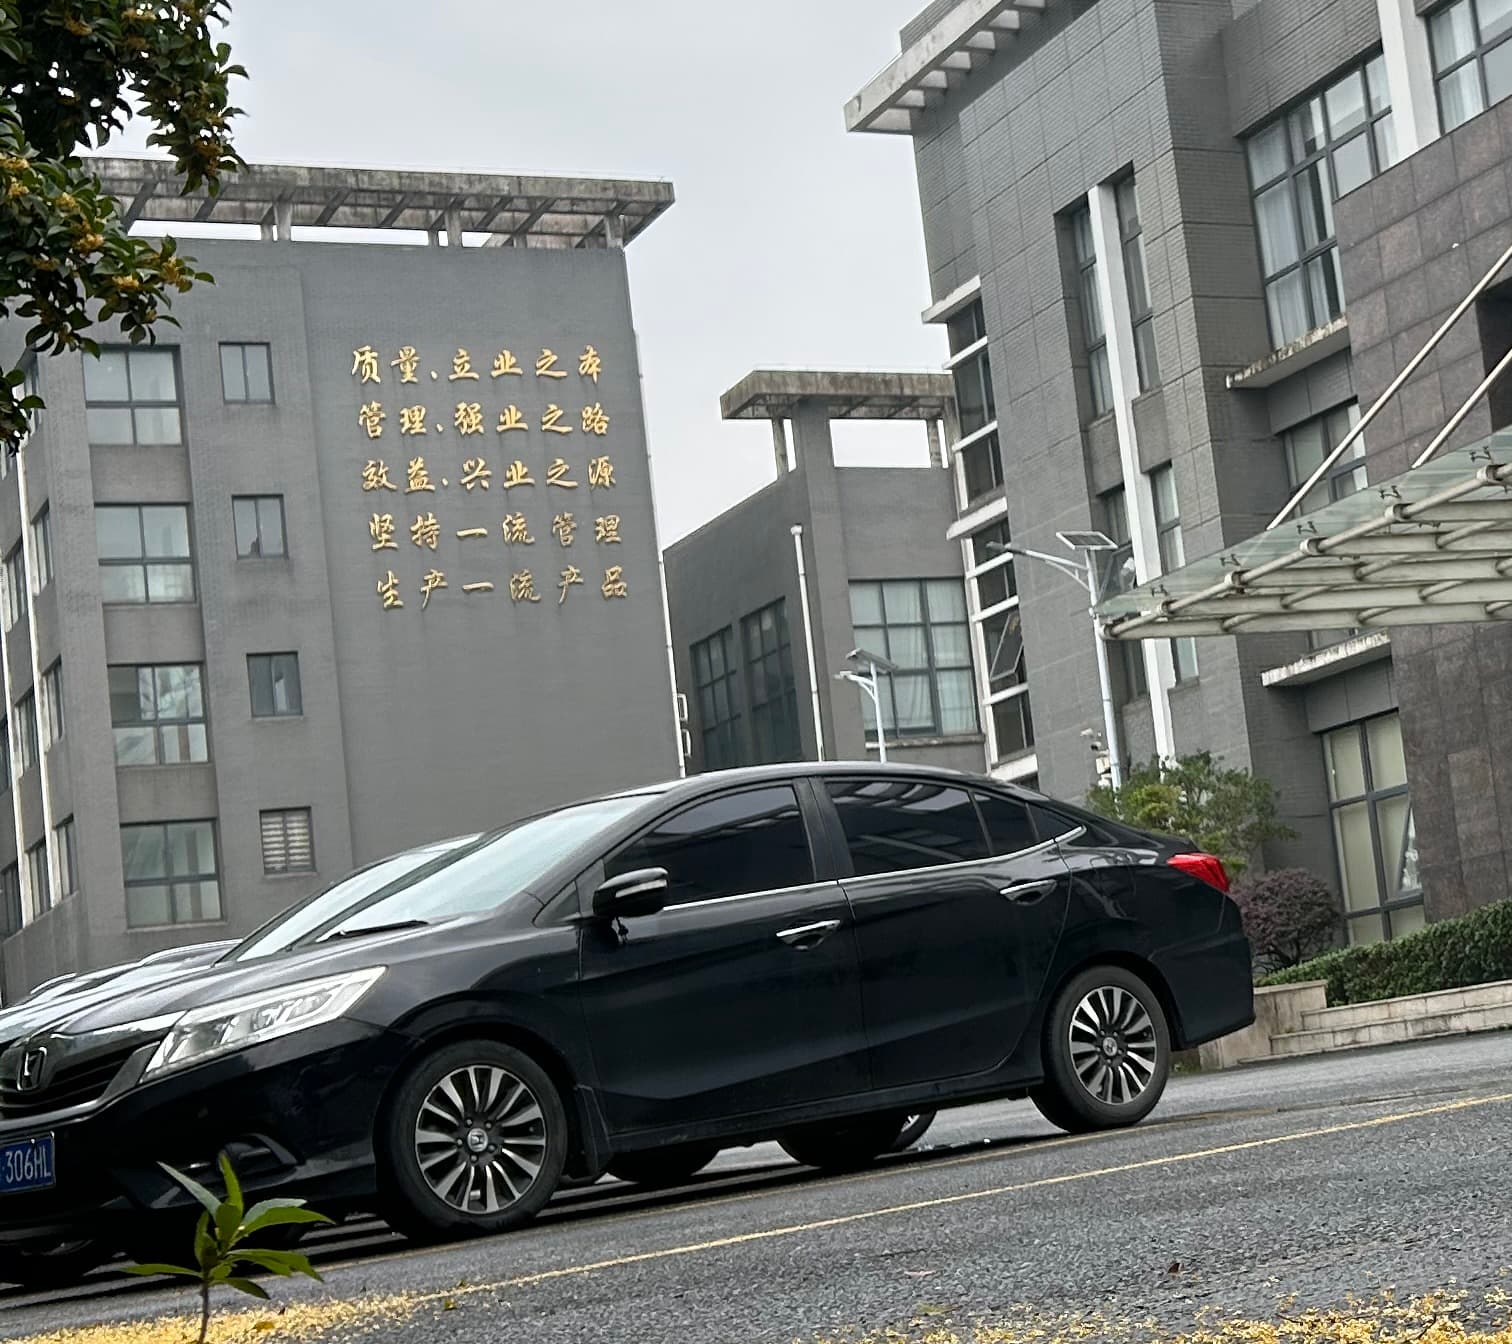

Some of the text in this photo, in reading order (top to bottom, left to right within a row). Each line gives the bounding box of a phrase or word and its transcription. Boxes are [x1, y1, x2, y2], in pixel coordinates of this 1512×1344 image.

[368, 512, 622, 551] 坚持一流管理
[376, 565, 628, 609] 生产一流产品
